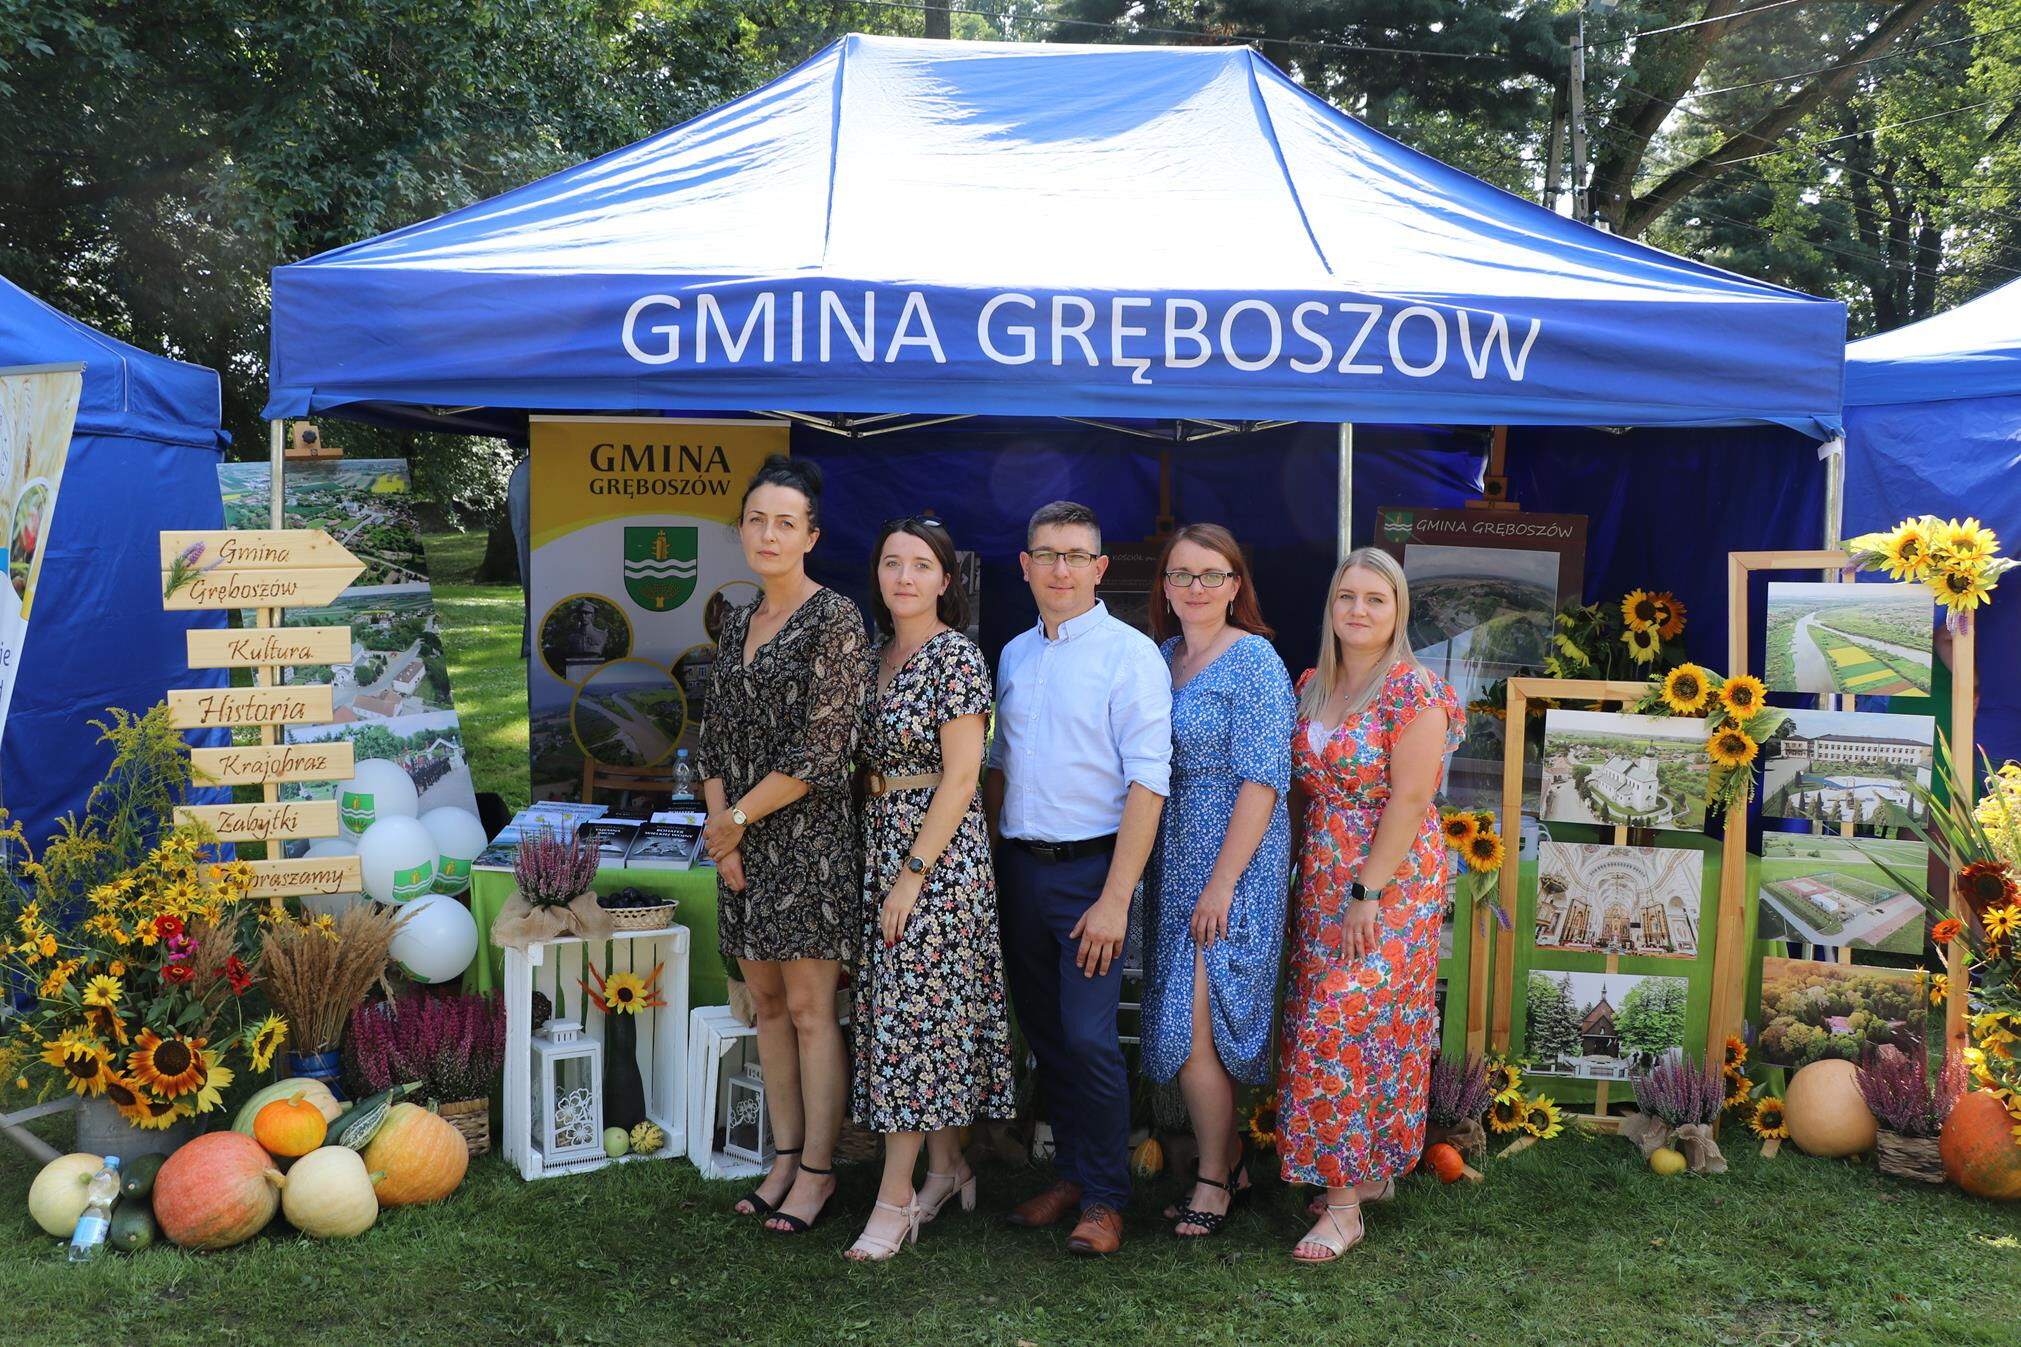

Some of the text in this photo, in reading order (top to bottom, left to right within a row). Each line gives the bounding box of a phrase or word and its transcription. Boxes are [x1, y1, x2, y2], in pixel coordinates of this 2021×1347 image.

[620, 289, 1542, 385] GMINA GRĘBOSZOW
[589, 443, 732, 474] GMINA
[588, 474, 732, 500] GRĘBOSZÓW
[1415, 518, 1574, 539] GMINA GRĘBOSZÓW
[219, 538, 290, 564] Gmina
[189, 572, 298, 605] Gręboszów
[228, 634, 313, 662] Kultura
[197, 694, 306, 725] Historia
[219, 747, 328, 784] Krajobraz
[216, 804, 299, 840] Zabytki
